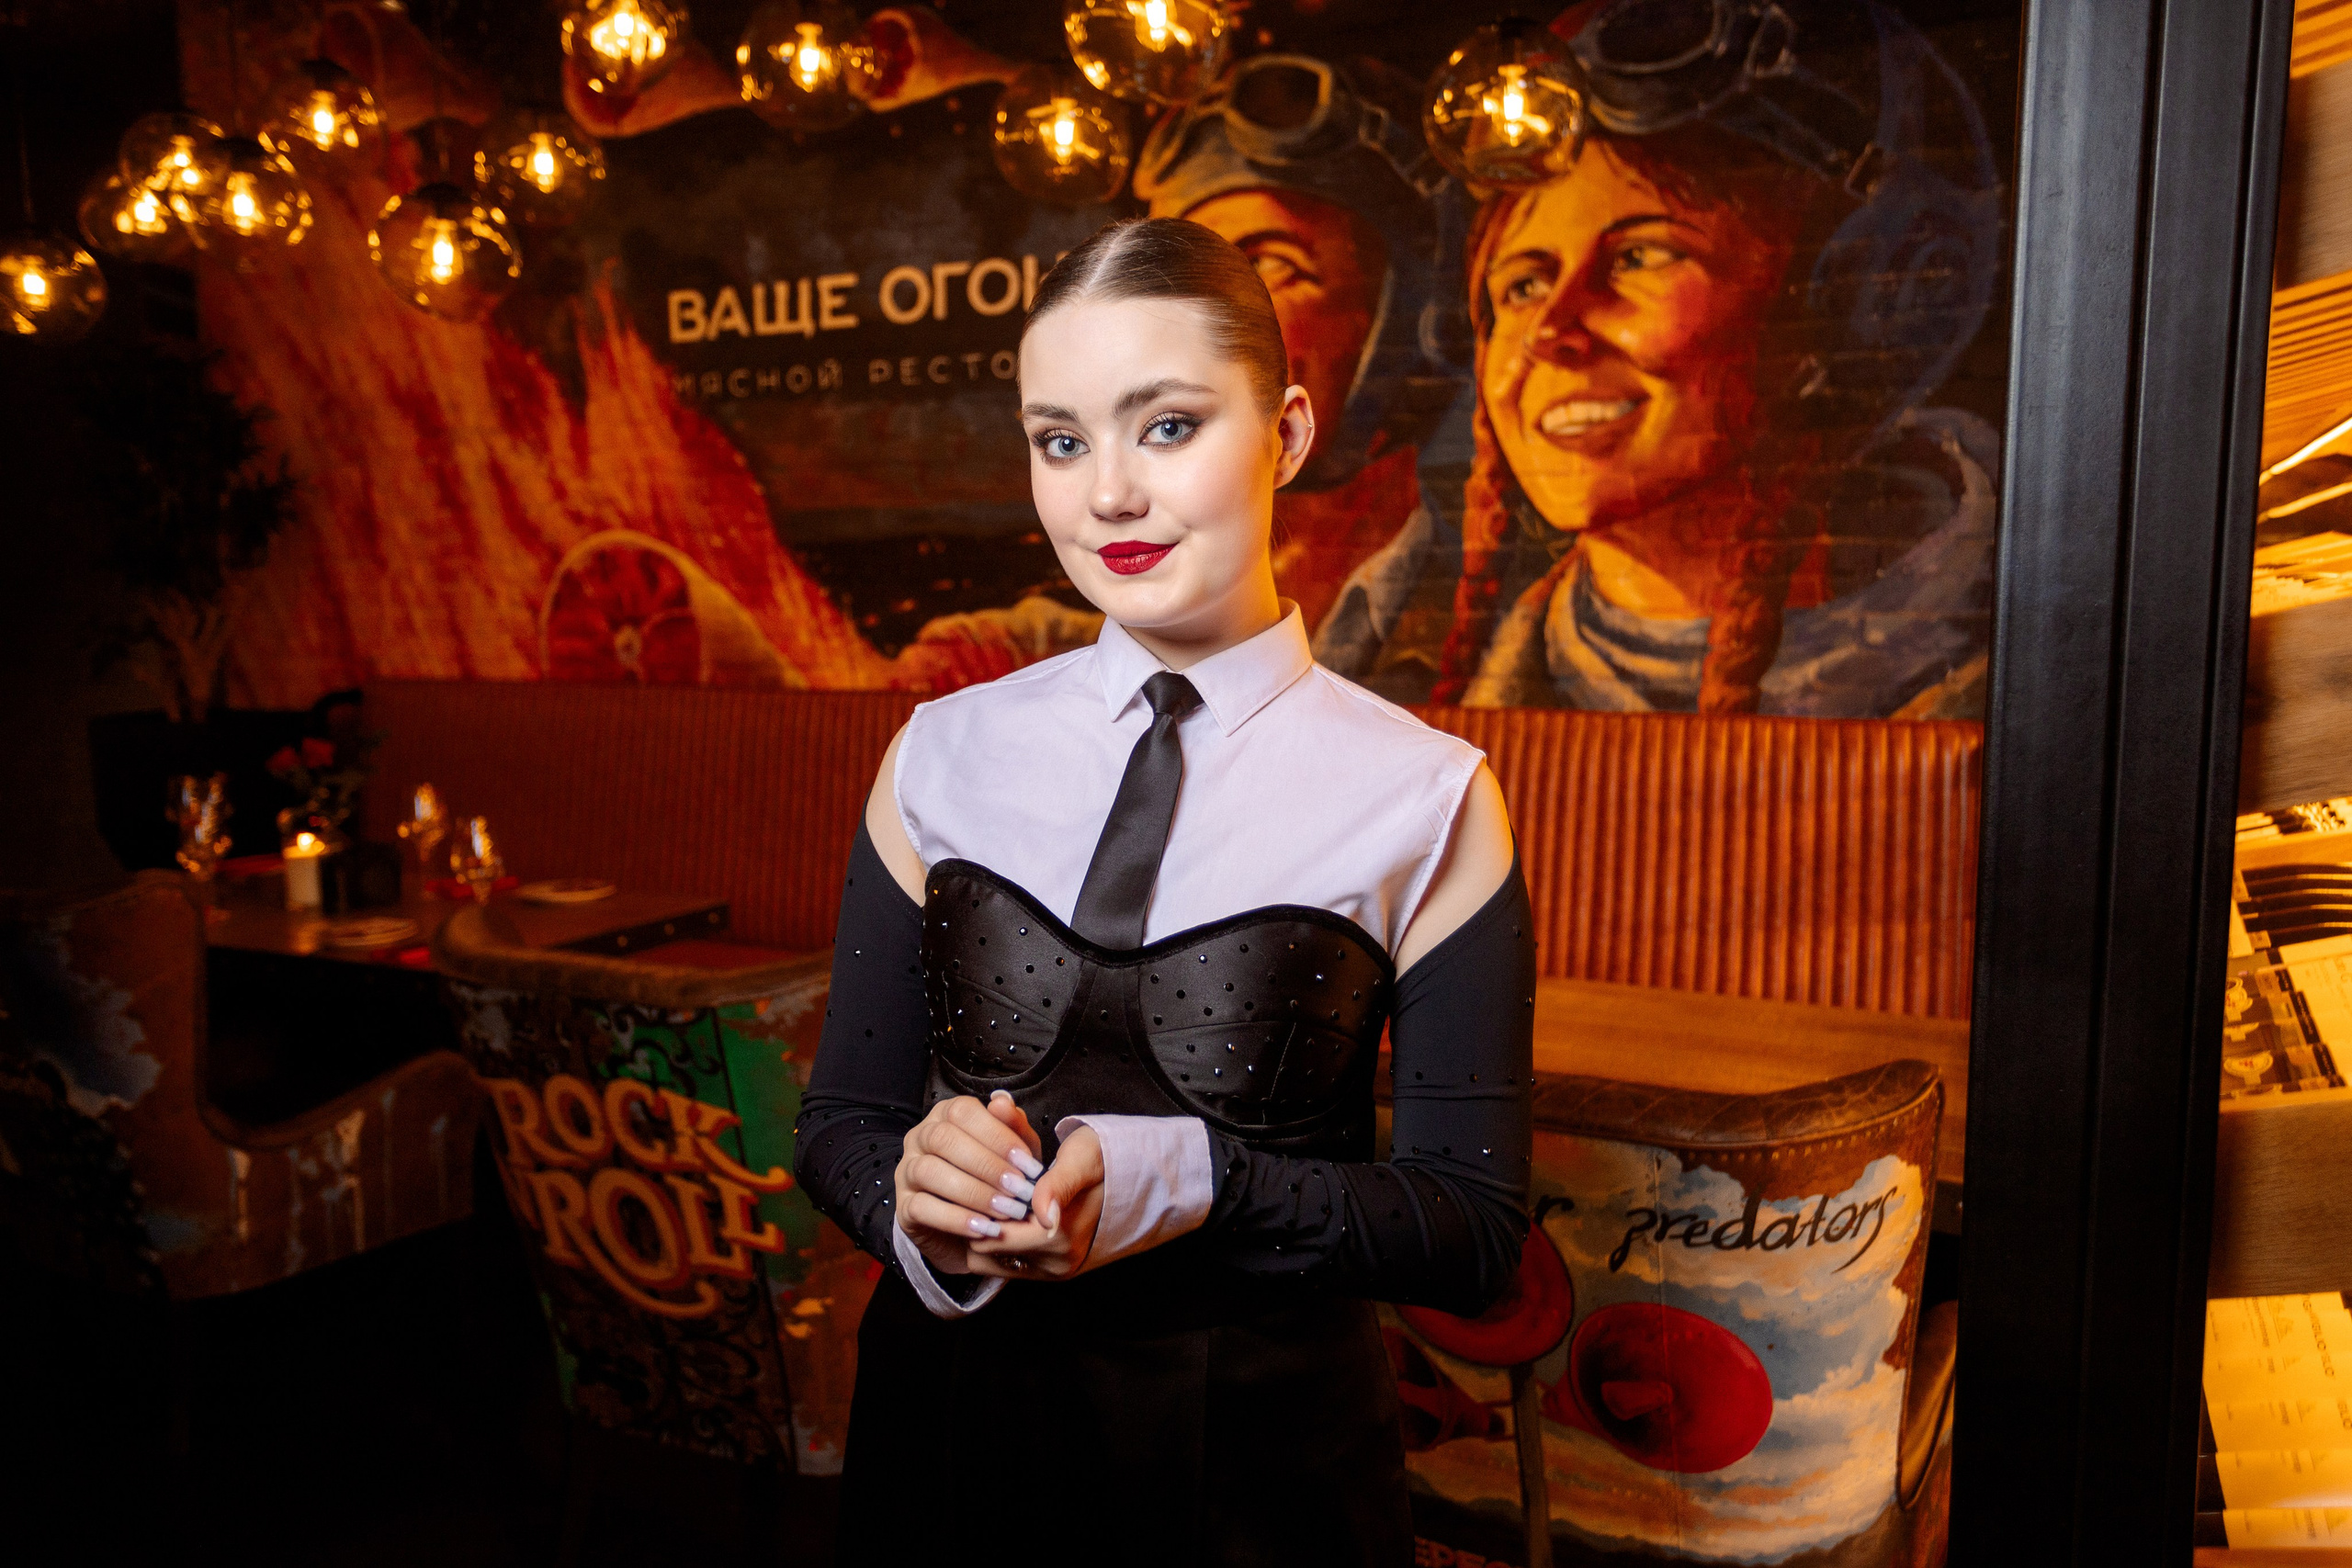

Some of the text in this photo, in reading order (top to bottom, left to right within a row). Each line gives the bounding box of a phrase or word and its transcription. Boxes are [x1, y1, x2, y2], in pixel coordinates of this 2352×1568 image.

[667, 273, 860, 344] ВАЩЕ
[484, 1074, 793, 1192] ROCK
[1610, 1183, 1898, 1274] predators
